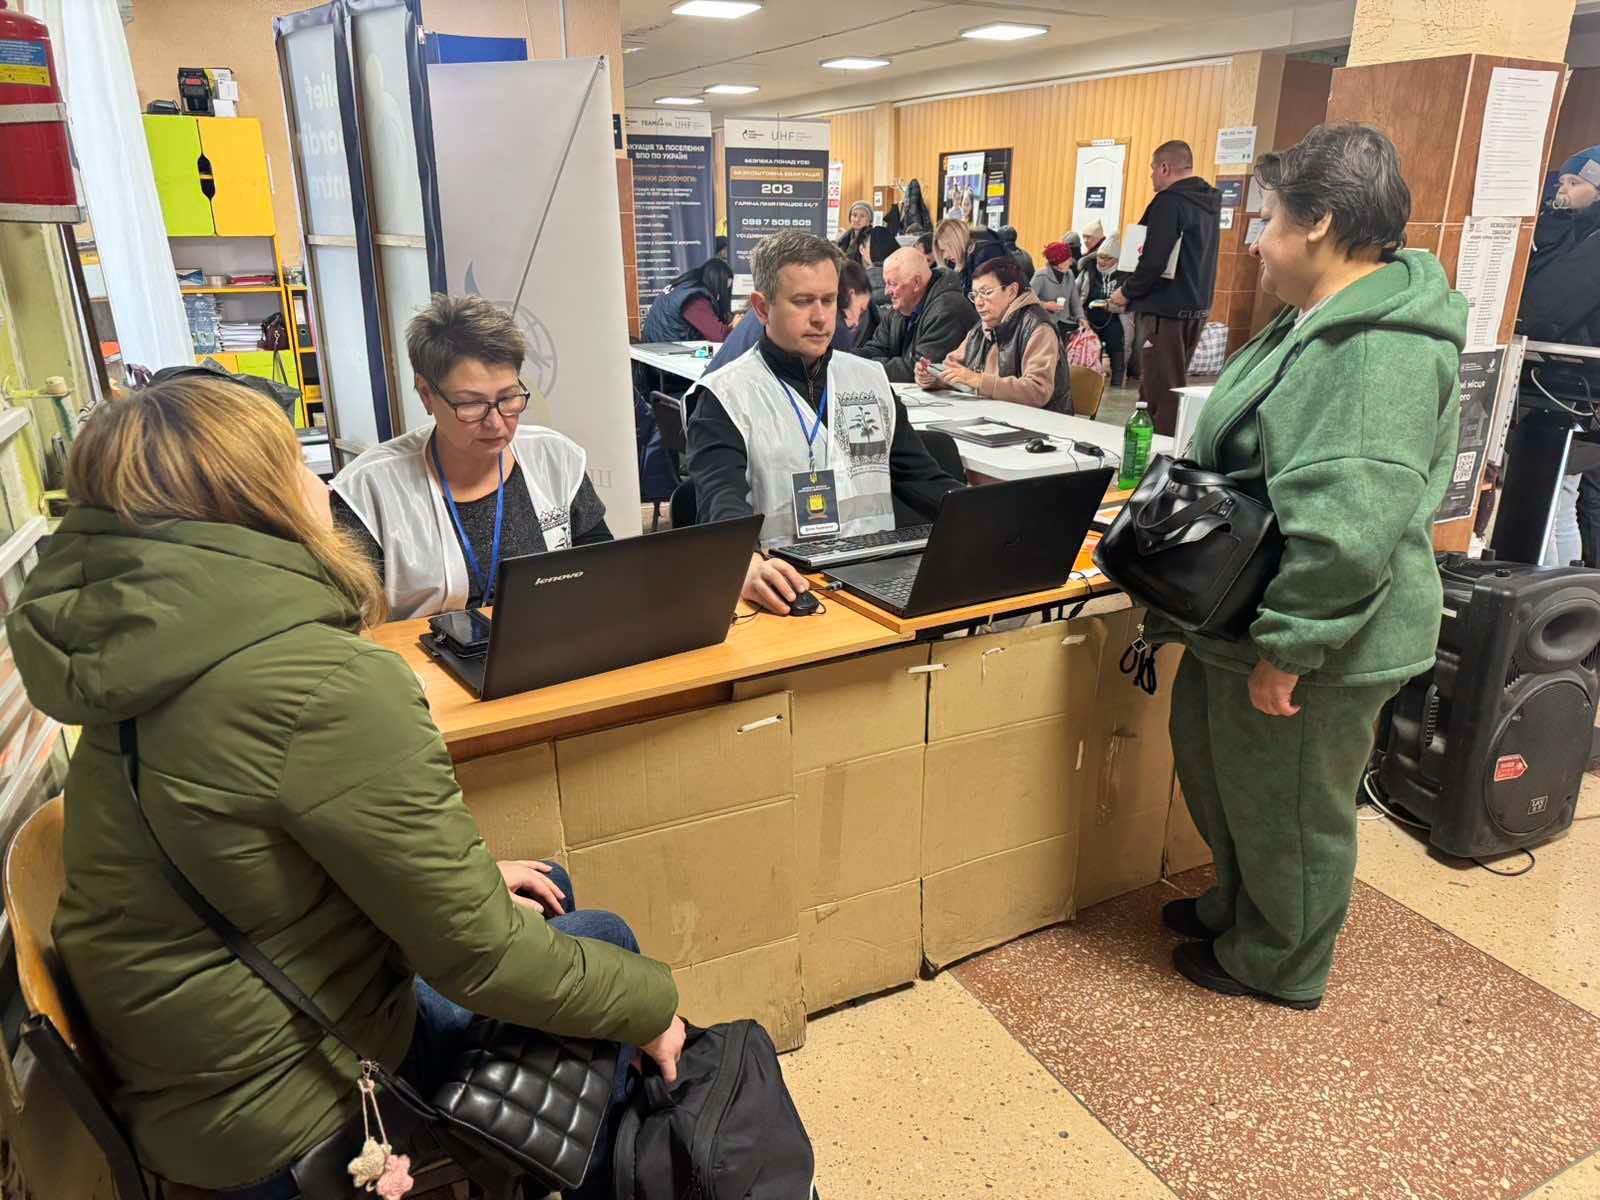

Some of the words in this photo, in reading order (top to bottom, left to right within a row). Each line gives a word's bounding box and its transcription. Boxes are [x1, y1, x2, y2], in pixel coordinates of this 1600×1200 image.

[771, 131, 796, 141] UHF
[761, 184, 793, 194] 203
[534, 572, 584, 586] lenovo
